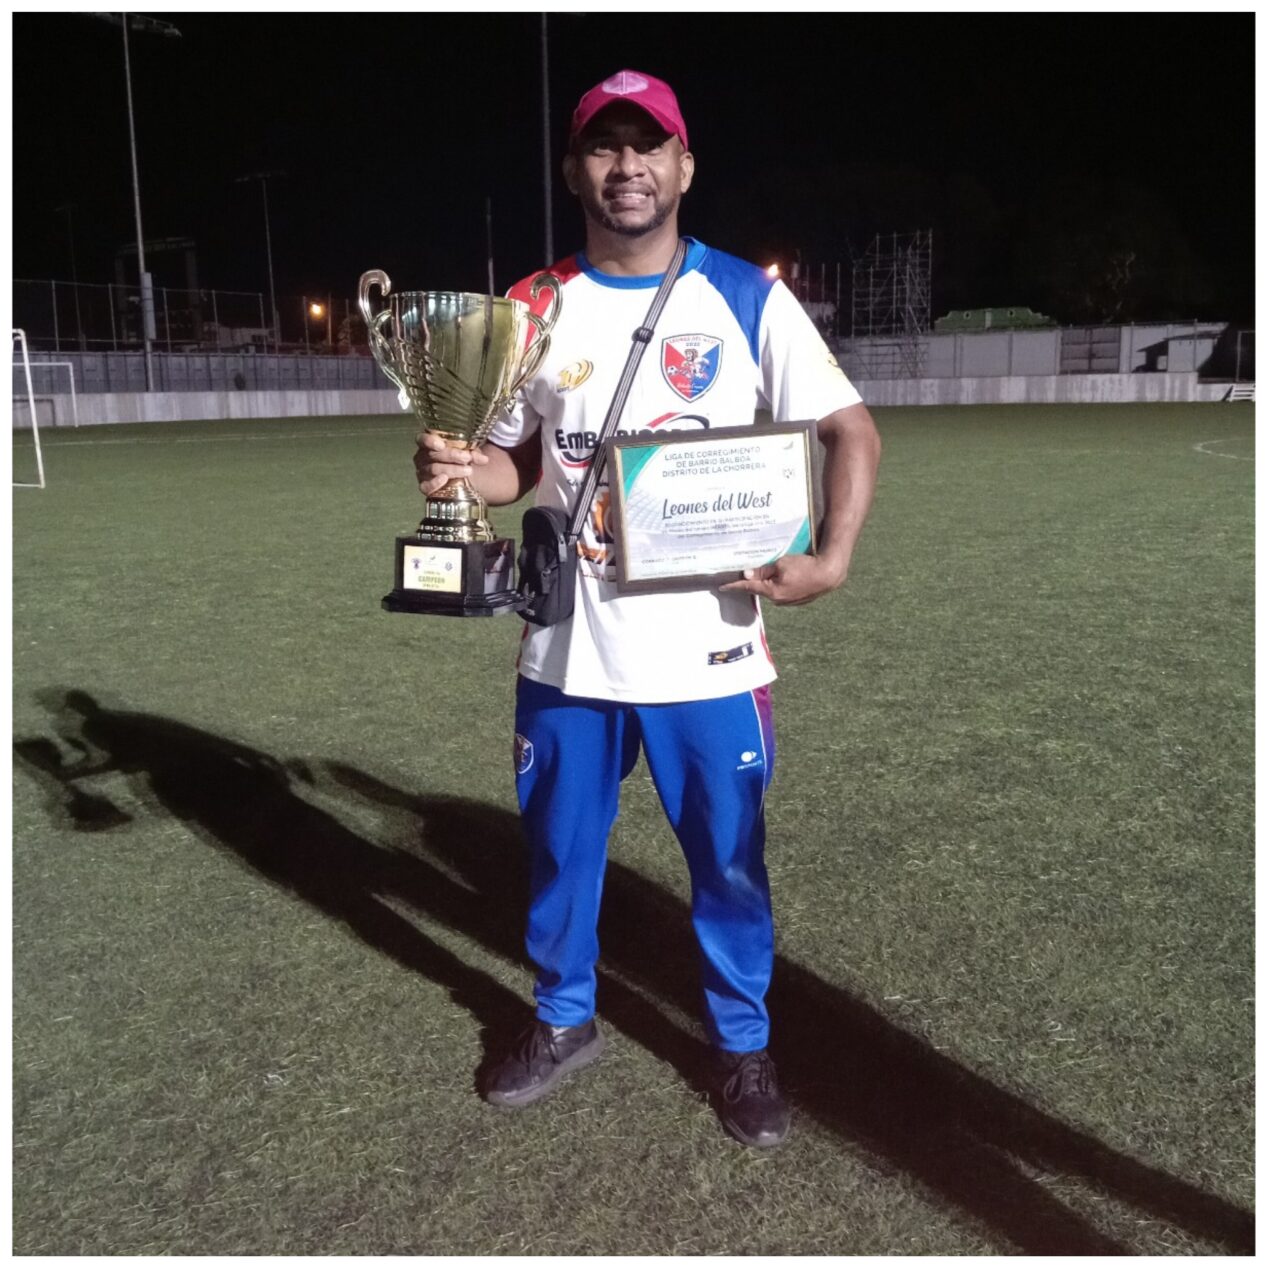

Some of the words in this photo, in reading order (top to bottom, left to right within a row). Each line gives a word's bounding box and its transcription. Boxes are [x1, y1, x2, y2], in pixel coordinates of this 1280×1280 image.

[664, 453, 683, 461] LIGA
[684, 451, 695, 460] DE
[696, 446, 761, 459] CORREGIMIENTO
[676, 460, 687, 468] DE
[688, 458, 718, 468] BARRIO
[719, 455, 751, 465] BALBOA
[662, 468, 698, 478] DISTRITO
[699, 466, 710, 475] DE
[722, 462, 766, 473] CHORRERA
[662, 498, 708, 520] Leones
[712, 492, 734, 513] del
[736, 490, 773, 510] West
